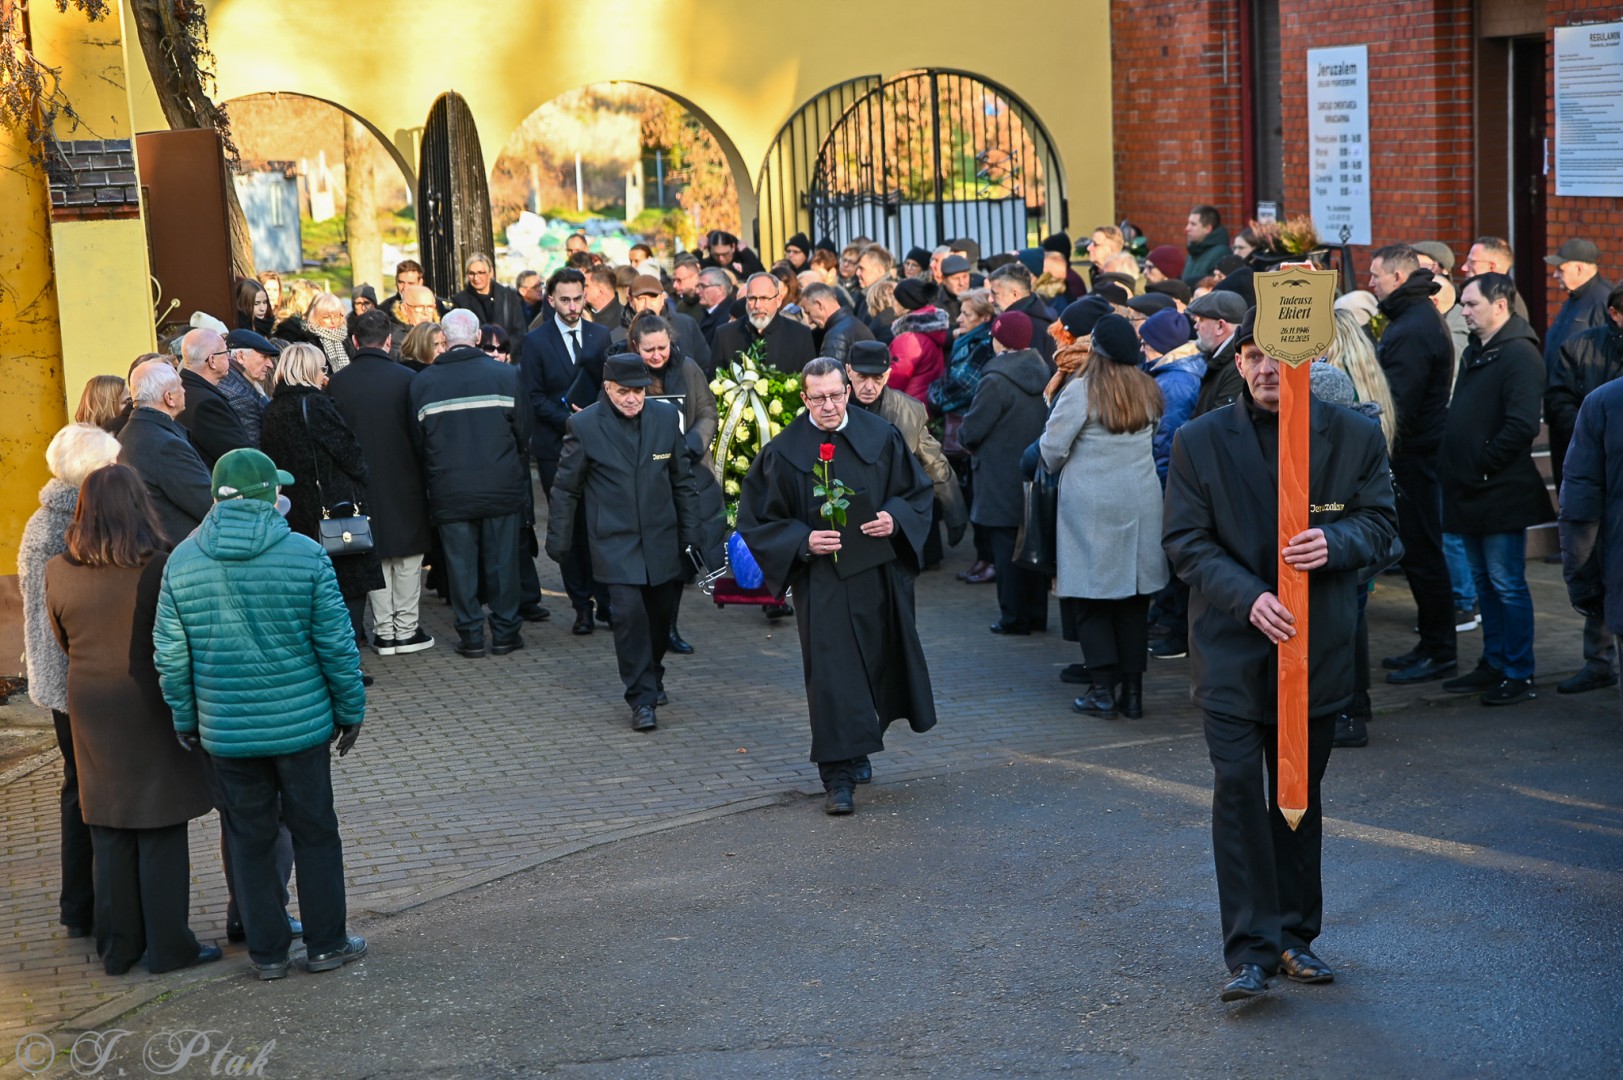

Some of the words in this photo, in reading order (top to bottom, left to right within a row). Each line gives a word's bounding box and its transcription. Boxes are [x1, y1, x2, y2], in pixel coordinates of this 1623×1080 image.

[1589, 31, 1620, 42] REGULAMIN
[1317, 61, 1357, 77] Jeruzalem
[1279, 296, 1313, 306] Tadeusz
[1278, 306, 1311, 320] Ekiert
[1280, 326, 1310, 335] 26.11.1946
[1280, 334, 1310, 343] 14.12.2025
